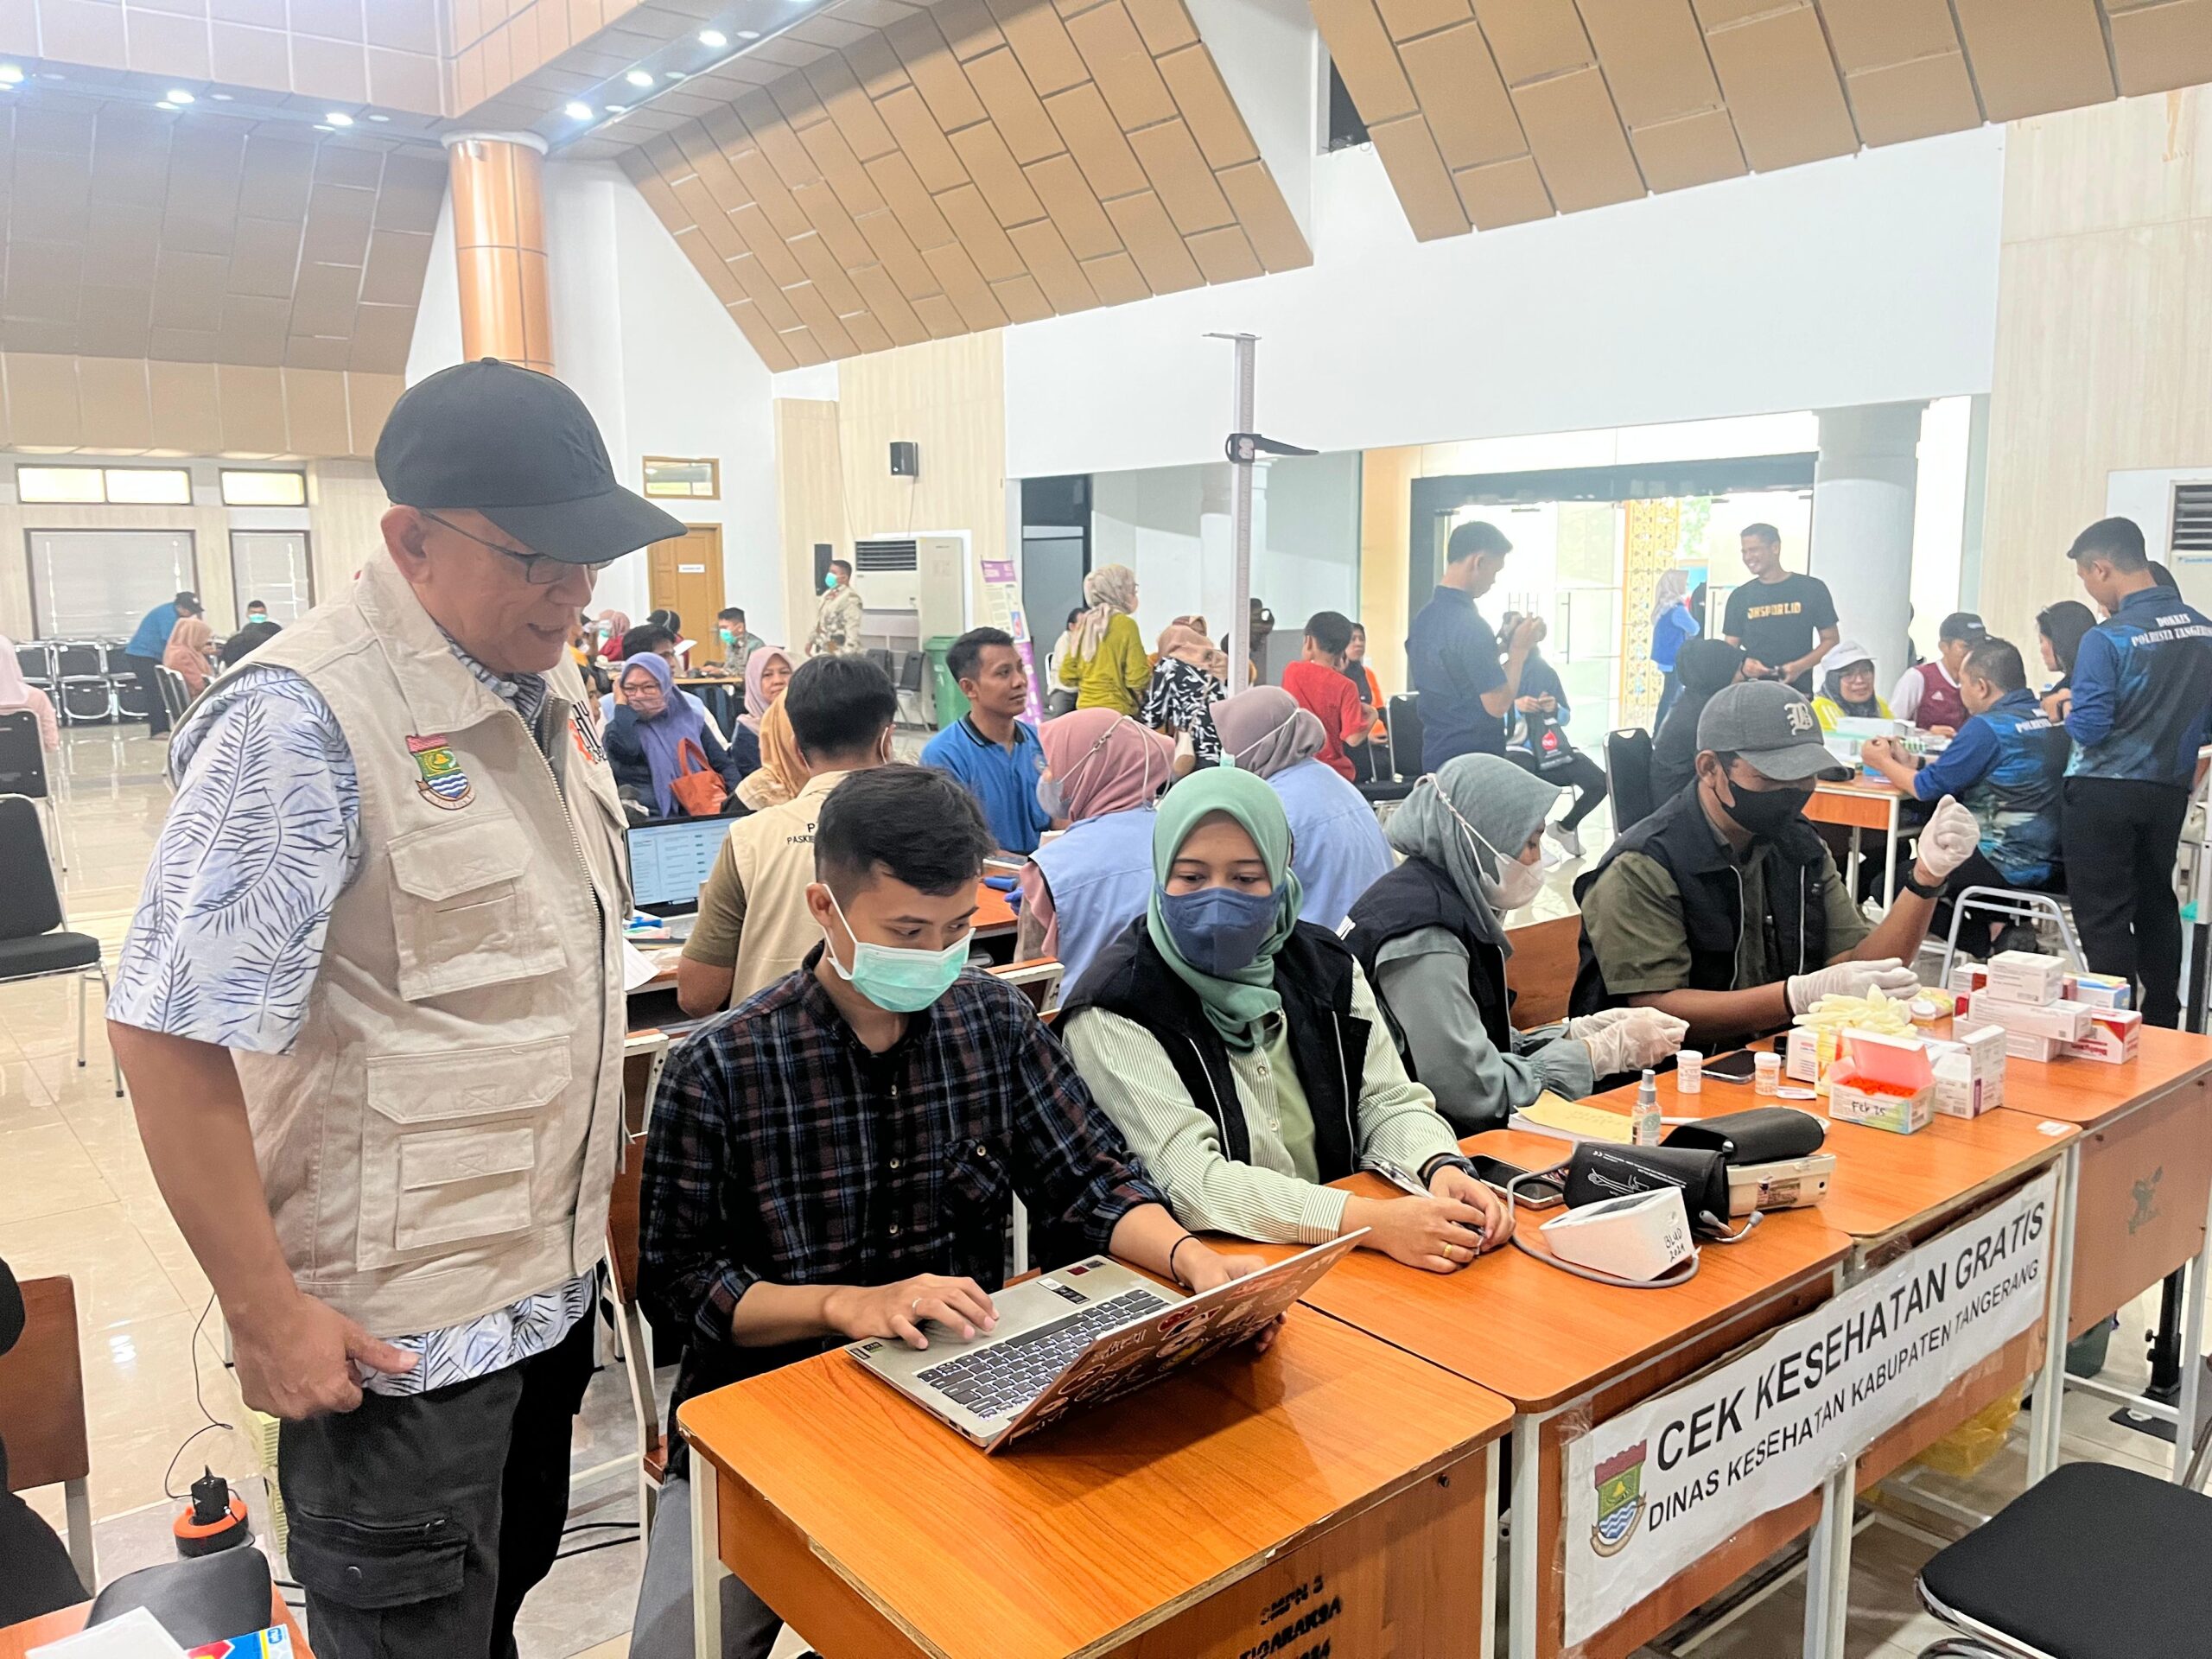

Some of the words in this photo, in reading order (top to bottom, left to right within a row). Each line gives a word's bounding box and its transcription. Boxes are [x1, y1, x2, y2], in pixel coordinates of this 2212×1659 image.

[1649, 1469, 1719, 1533] DINAS
[1727, 1389, 1845, 1487] KESEHATAN
[1851, 1319, 1952, 1408] KABUPATEN
[1955, 1259, 2039, 1334] TANGERANG
[1657, 1386, 1746, 1471] CEK
[1754, 1262, 1948, 1421] KESEHATAN
[1955, 1201, 2045, 1290] GRATIS
